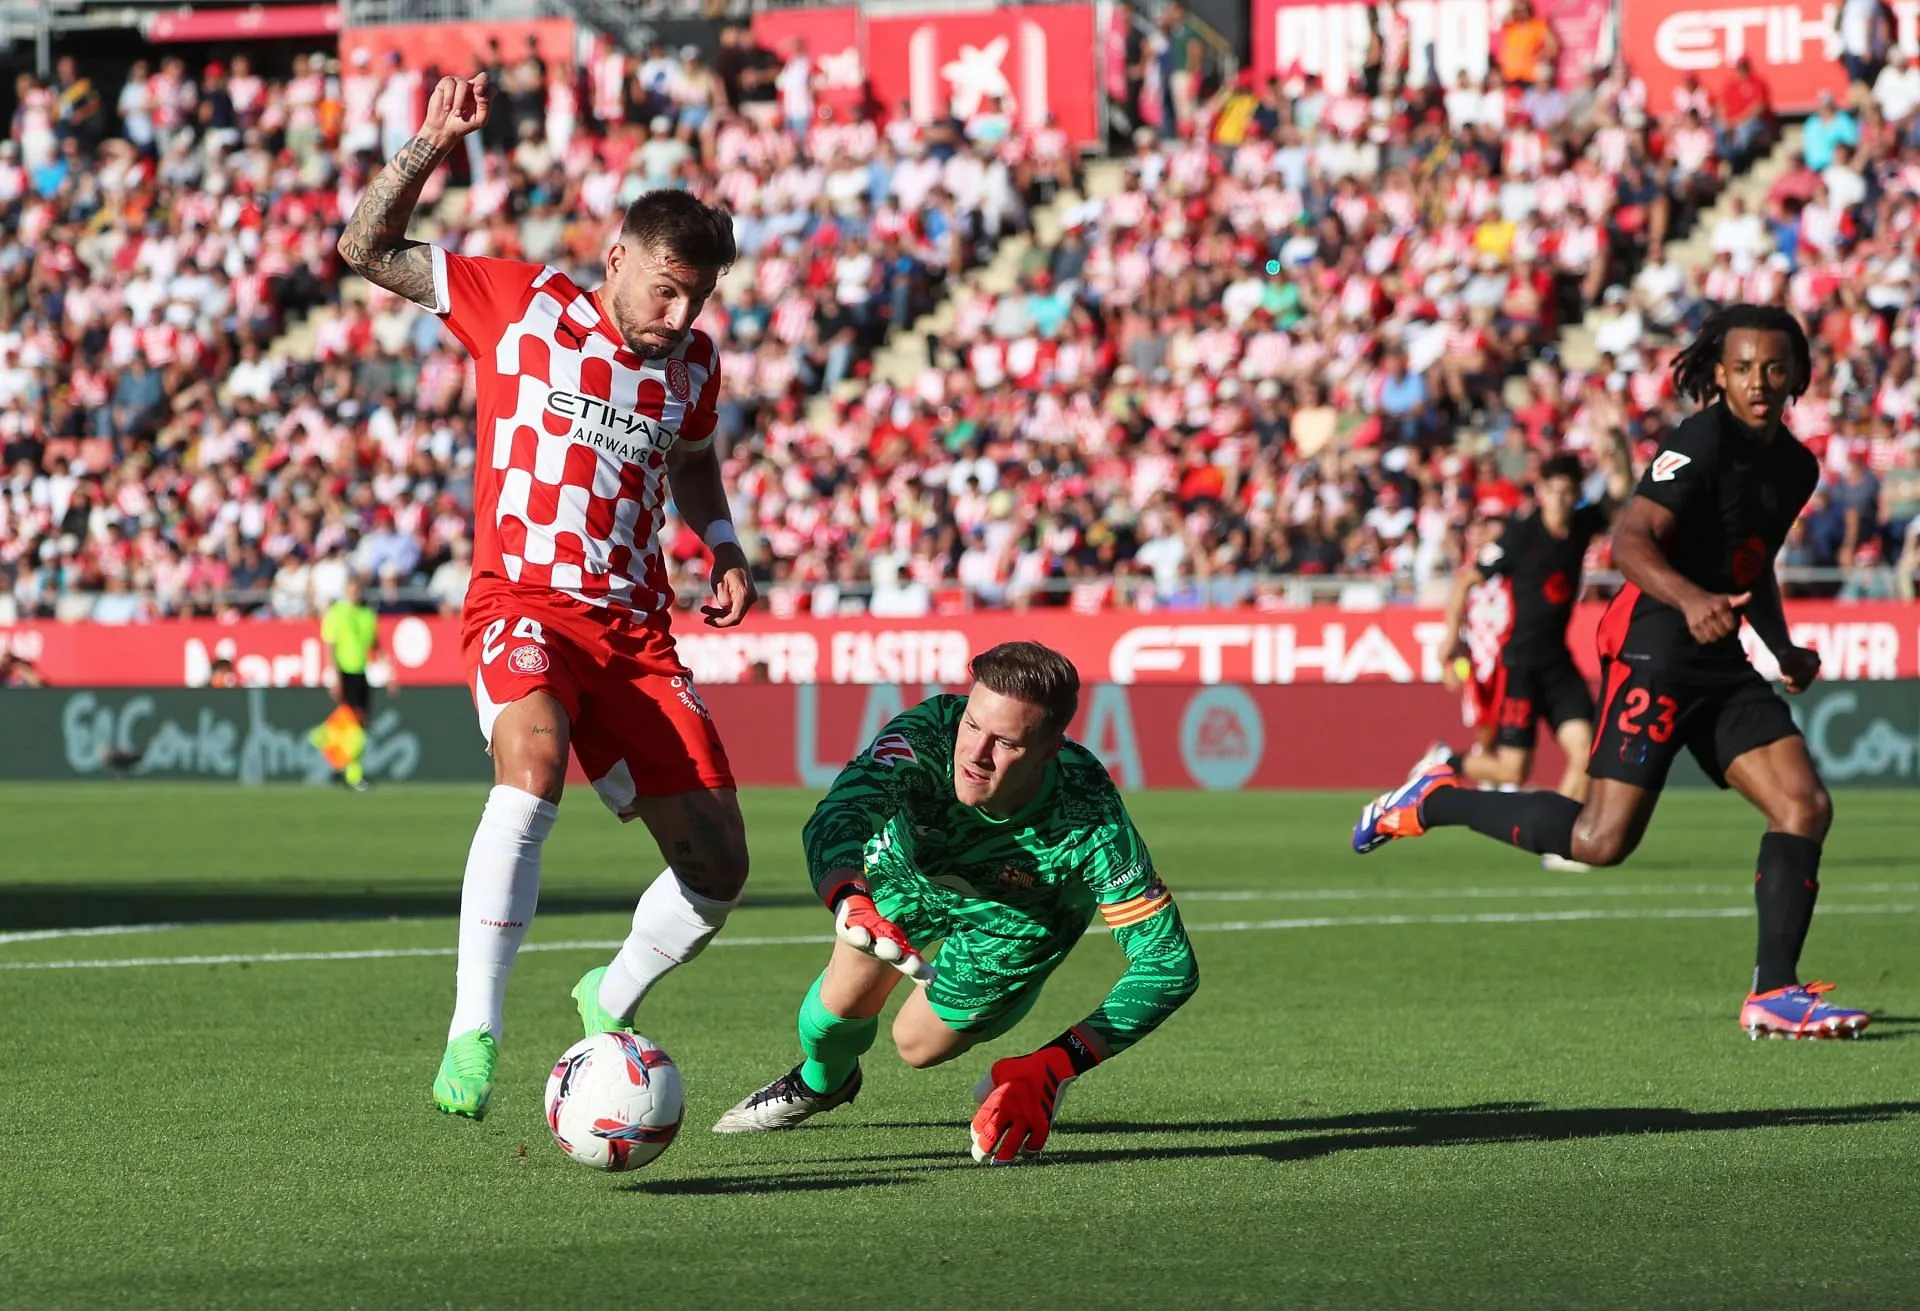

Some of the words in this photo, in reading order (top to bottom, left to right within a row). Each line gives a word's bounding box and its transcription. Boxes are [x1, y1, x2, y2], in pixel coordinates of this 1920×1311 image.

[547, 390, 674, 451] ETIHAD
[573, 427, 649, 464] AIRWAYS
[481, 616, 547, 665] 24
[1618, 687, 1678, 743] 23
